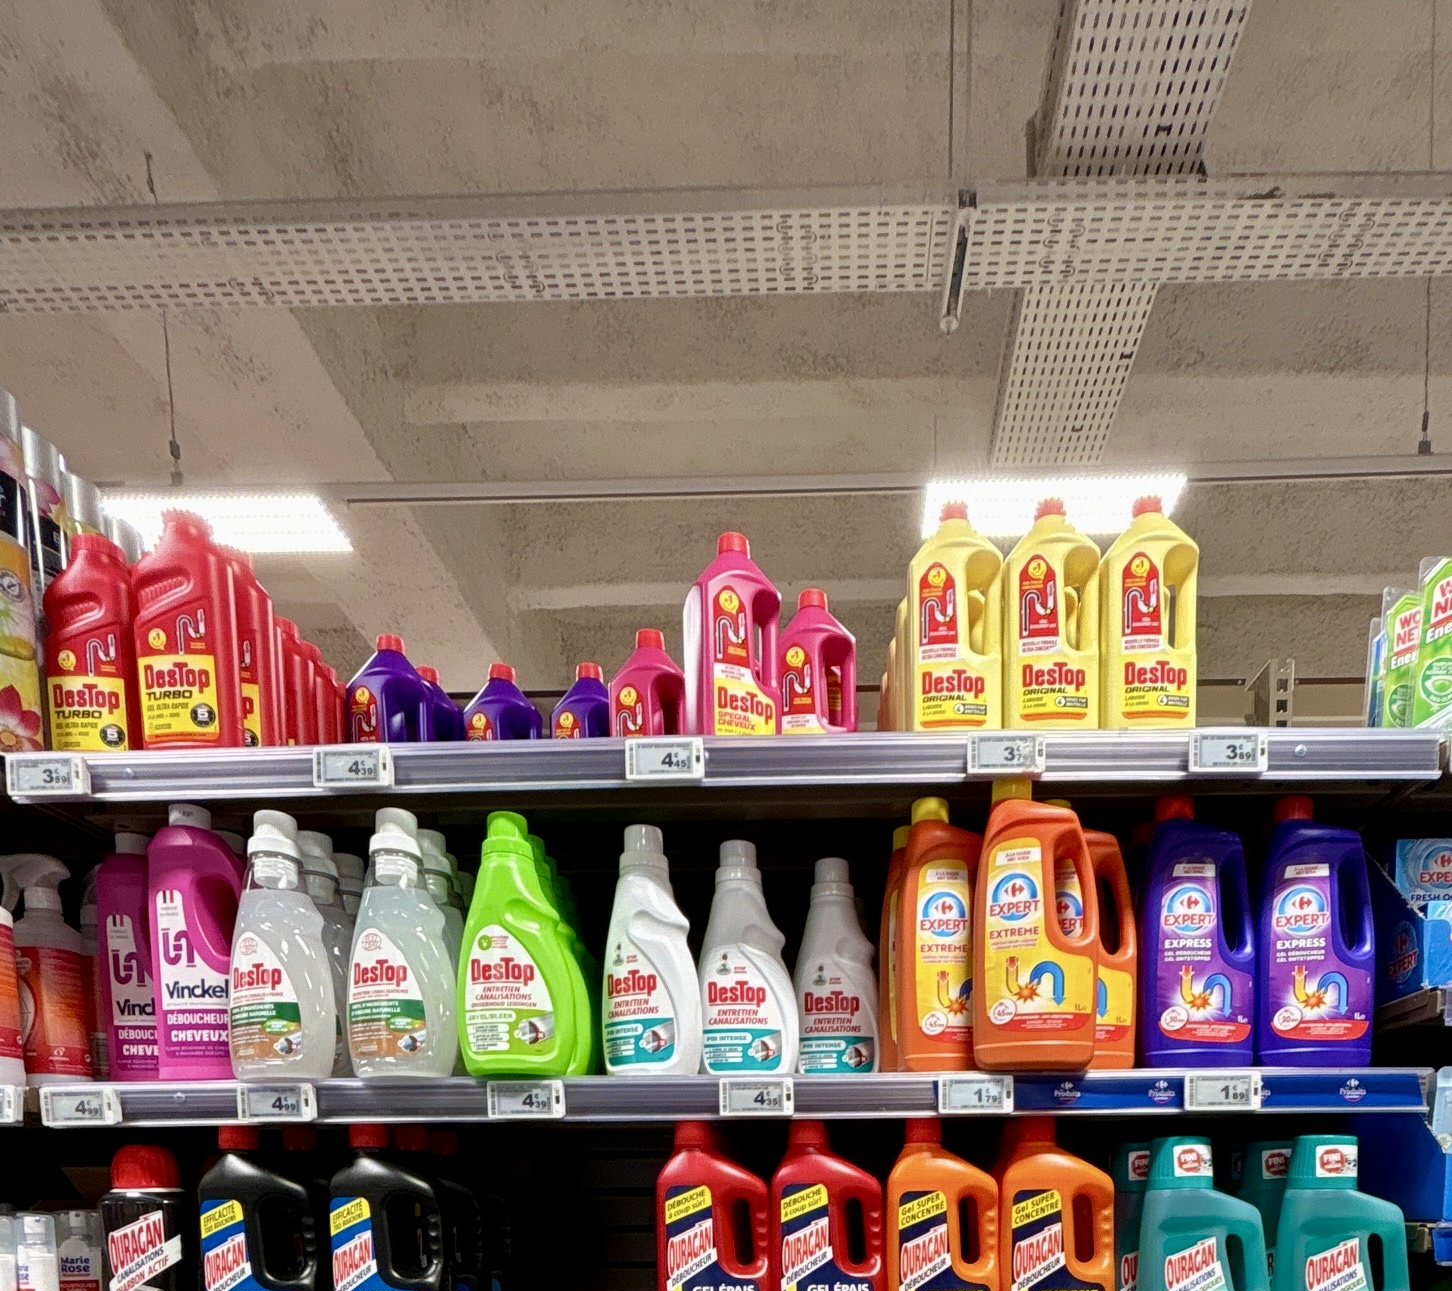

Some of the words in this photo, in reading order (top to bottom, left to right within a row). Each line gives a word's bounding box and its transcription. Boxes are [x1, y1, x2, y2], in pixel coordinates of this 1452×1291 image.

[144, 662, 210, 694] DesTop
[922, 669, 984, 698] DesTop
[1023, 662, 1085, 690] DesTop
[1124, 661, 1187, 689] DesTop
[53, 684, 120, 714] DesTop
[146, 690, 192, 701] TURBO
[922, 694, 967, 703] ORIGINAL
[1023, 687, 1068, 696] ORIGINAL
[1125, 685, 1169, 694] ORIGINAL
[55, 710, 102, 719] TURBO
[717, 686, 773, 725] DesTop
[990, 900, 1040, 917] EXPERT
[920, 919, 968, 931] EXPERT
[1164, 914, 1213, 927] EXPERT
[1276, 912, 1329, 928] EXPERT
[990, 926, 1039, 940] EXTREME
[1165, 939, 1212, 949] EXPRESS
[1277, 938, 1326, 949] EXPRESS
[920, 944, 967, 953] EXTREME
[233, 963, 282, 990] DesTop
[354, 959, 407, 987] DesTop
[471, 957, 534, 986] DesTop
[165, 979, 228, 1000] Vinckel
[607, 970, 656, 997] DesTop
[708, 981, 766, 1007] DesTop
[608, 1006, 659, 1019] CANALISATIONS
[613, 999, 649, 1009] ENTRETIEN
[717, 1009, 758, 1017] ENTRETIEN
[805, 991, 860, 1016] DesTop
[708, 1017, 768, 1026] CANALISATIONS
[805, 1024, 861, 1034] CANALISATIONS
[813, 1017, 852, 1025] ENTRETIEN
[667, 1189, 706, 1211] DÉBOUCHE
[782, 1188, 822, 1210] DÉBOUCHE
[111, 1218, 163, 1276] OURAGAN
[668, 1224, 712, 1273] OURAGAN
[783, 1223, 829, 1273] OURAGAN
[901, 1228, 948, 1280] OURAGAN
[1014, 1227, 1061, 1280] OURAGAN
[205, 1237, 245, 1290] OURAGAN
[334, 1235, 371, 1288] OURAGAN
[1167, 1242, 1216, 1288] OURAGAN
[1306, 1244, 1358, 1291] OURAGAN
